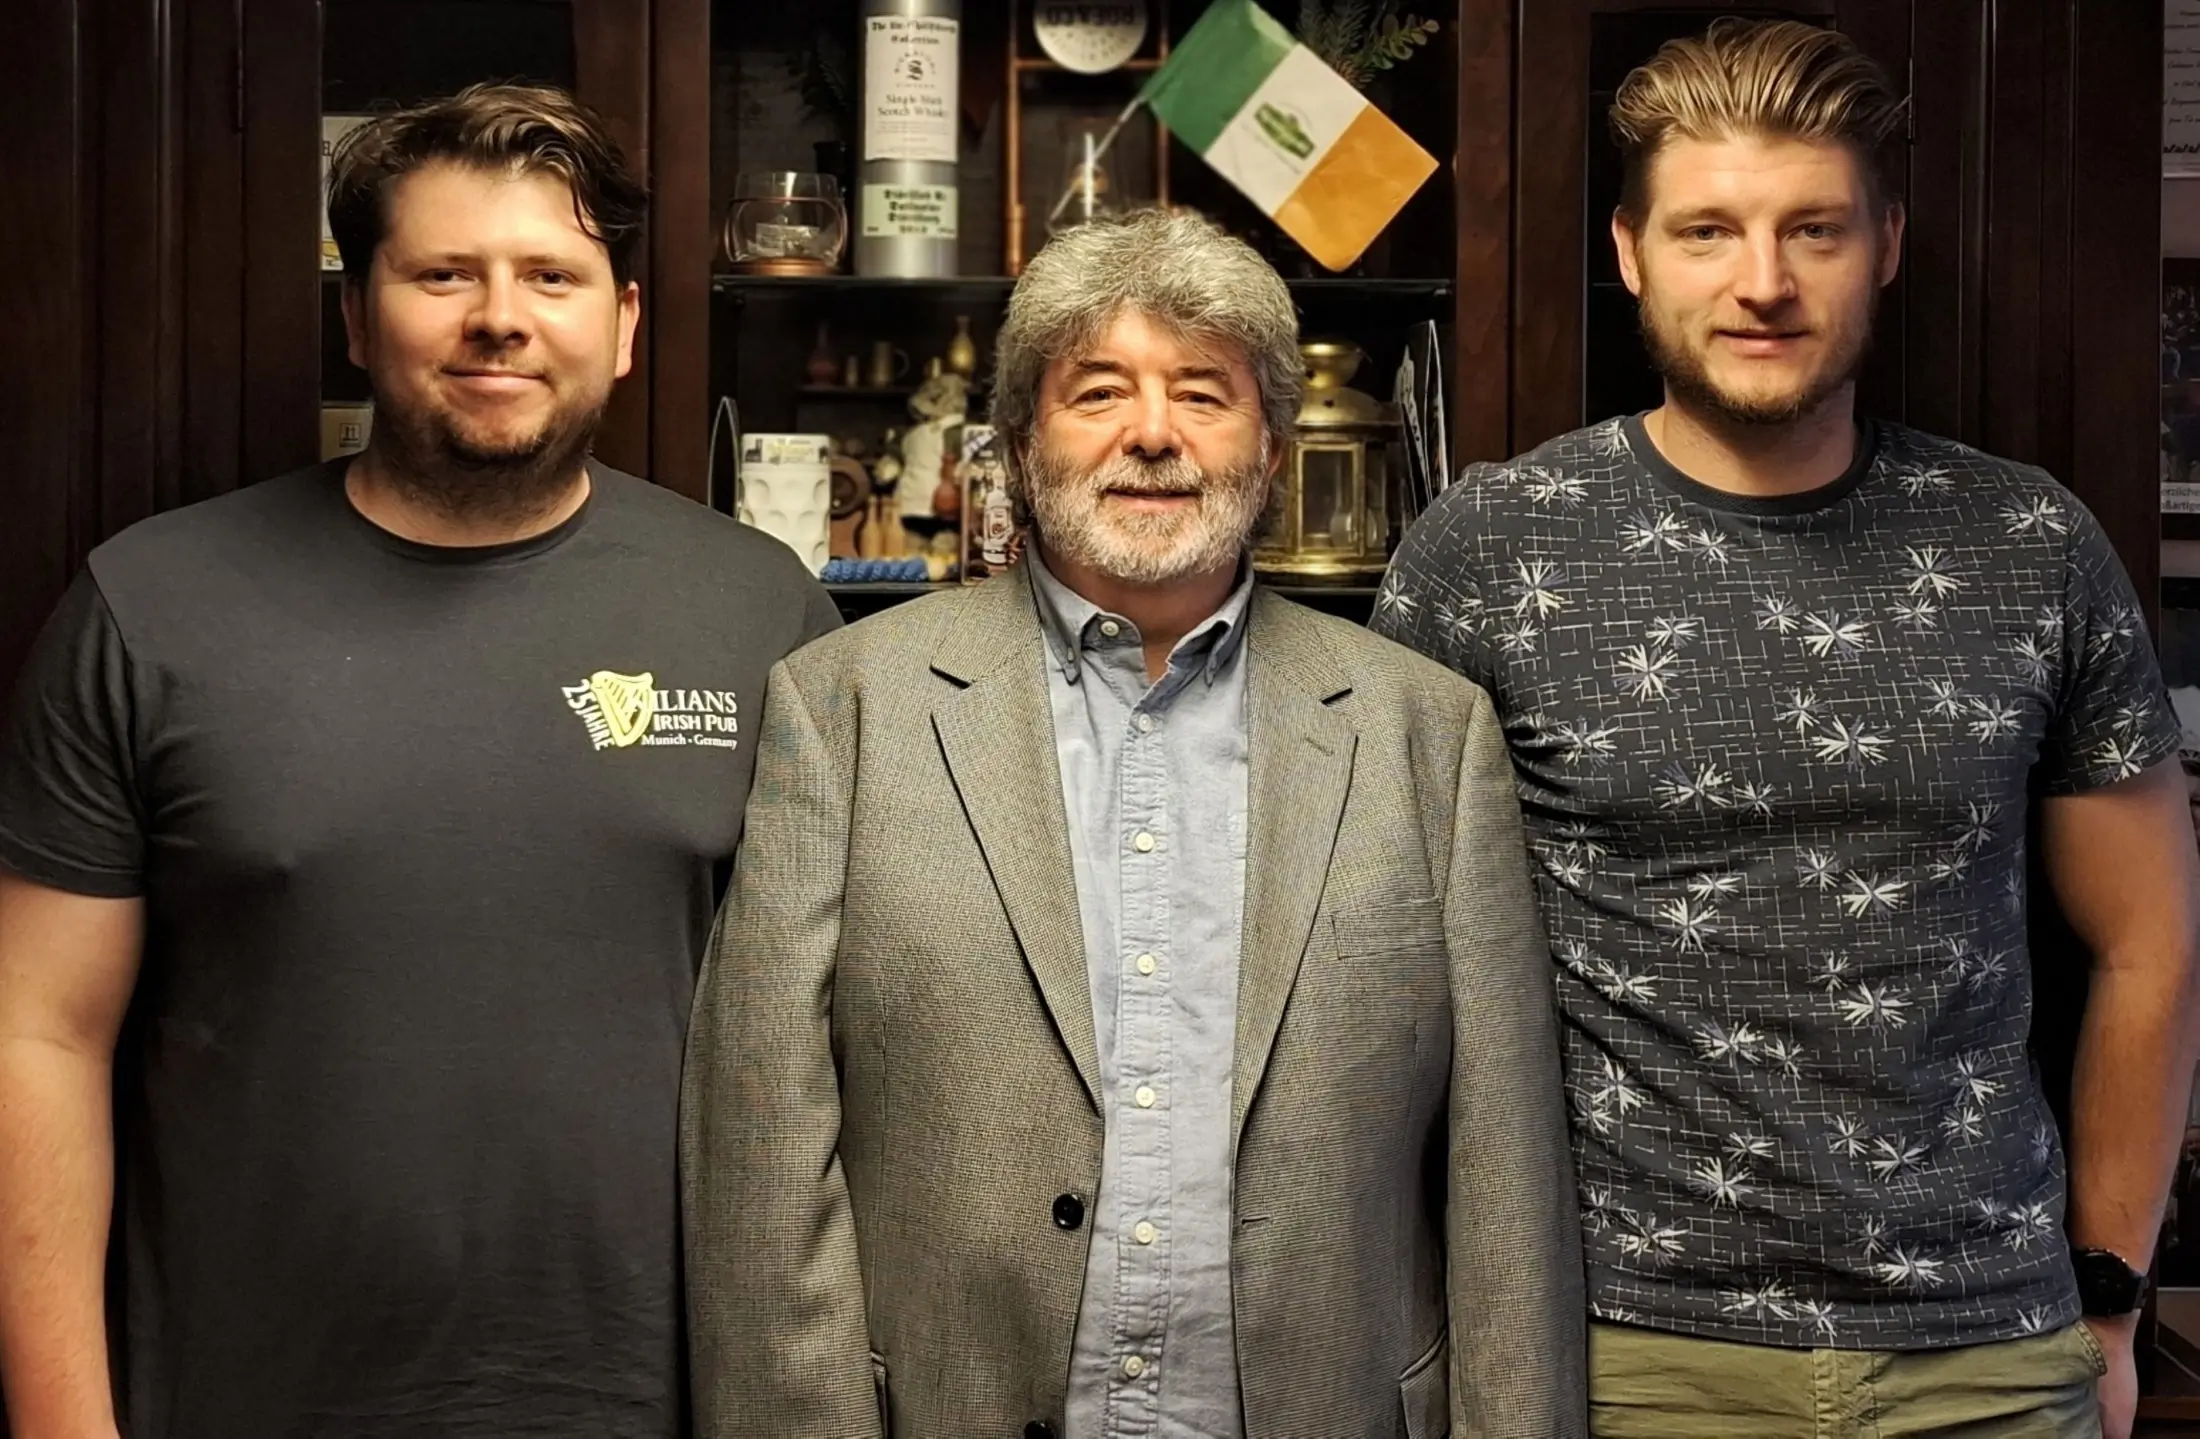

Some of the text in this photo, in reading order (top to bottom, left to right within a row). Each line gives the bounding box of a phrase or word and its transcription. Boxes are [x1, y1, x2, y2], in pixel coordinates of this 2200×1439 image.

[561, 678, 600, 711] 25
[574, 704, 616, 751] JAHRE
[653, 713, 738, 733] IRISH PUB
[640, 733, 738, 751] Munich Germany
